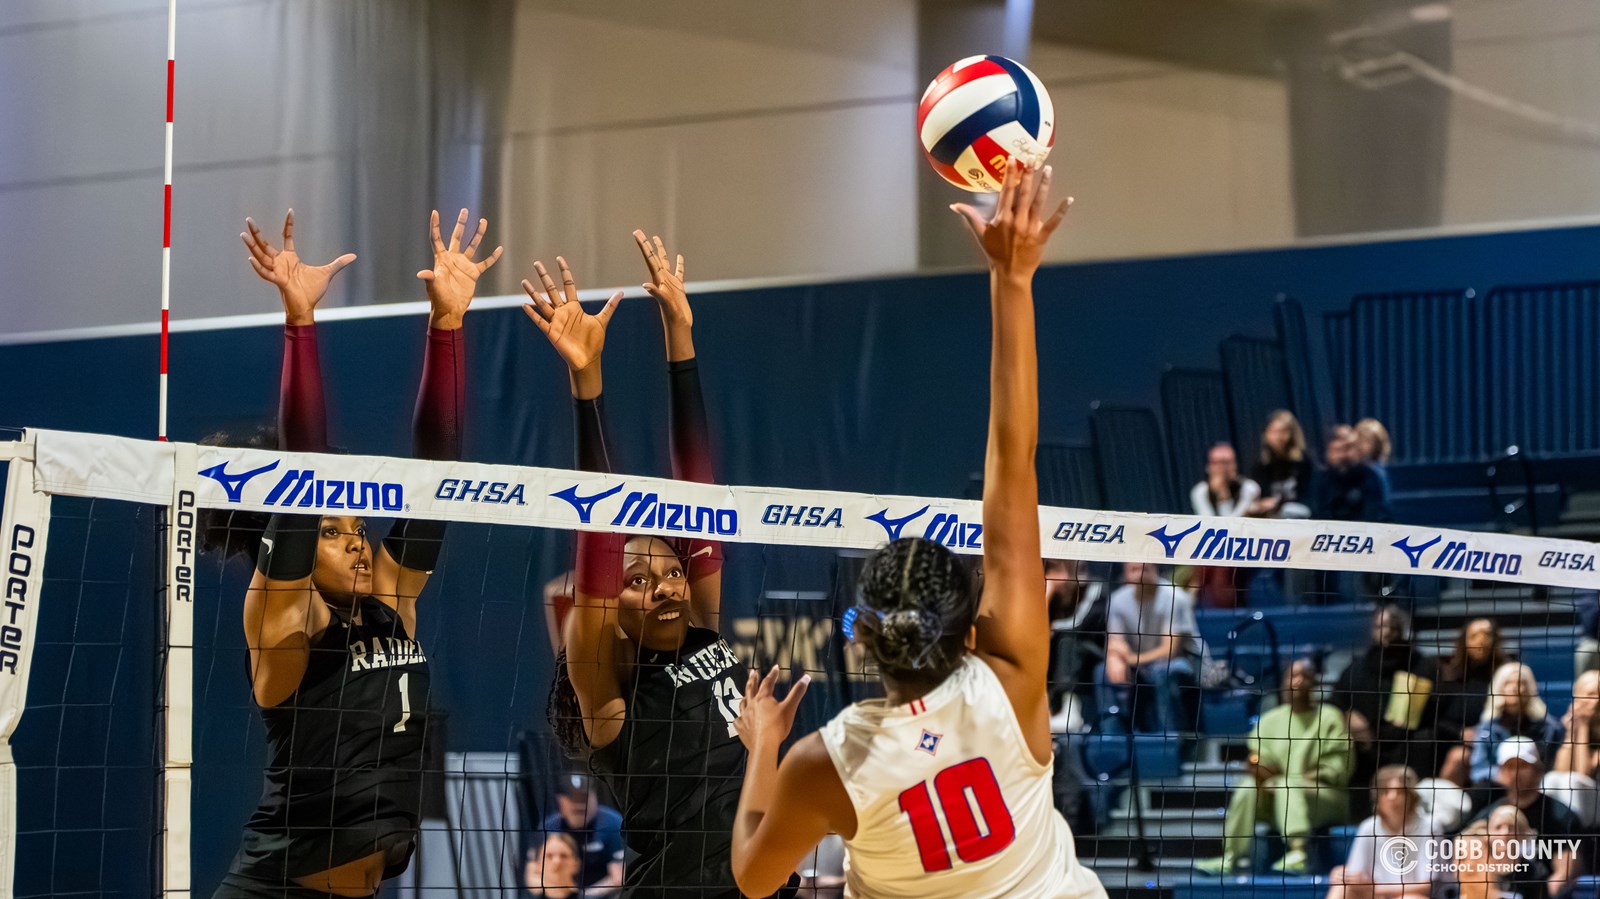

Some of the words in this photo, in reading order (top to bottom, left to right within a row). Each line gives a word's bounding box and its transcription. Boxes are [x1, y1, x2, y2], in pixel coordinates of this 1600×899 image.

[175, 490, 195, 602] PORTER
[263, 469, 403, 512] MIZUNO
[434, 478, 527, 506] GHSA
[610, 492, 738, 536] MIZUNO
[761, 504, 843, 528] GHSA
[923, 513, 983, 548] MIZ
[1052, 521, 1125, 544] GHSA
[1190, 528, 1291, 562] MIZUNO
[1310, 534, 1374, 554] GHSA
[1432, 541, 1522, 576] MIZUNO
[1538, 551, 1596, 572] GHSA
[0, 524, 35, 674] PORTER
[393, 673, 411, 733] 1
[898, 756, 1016, 873] 10
